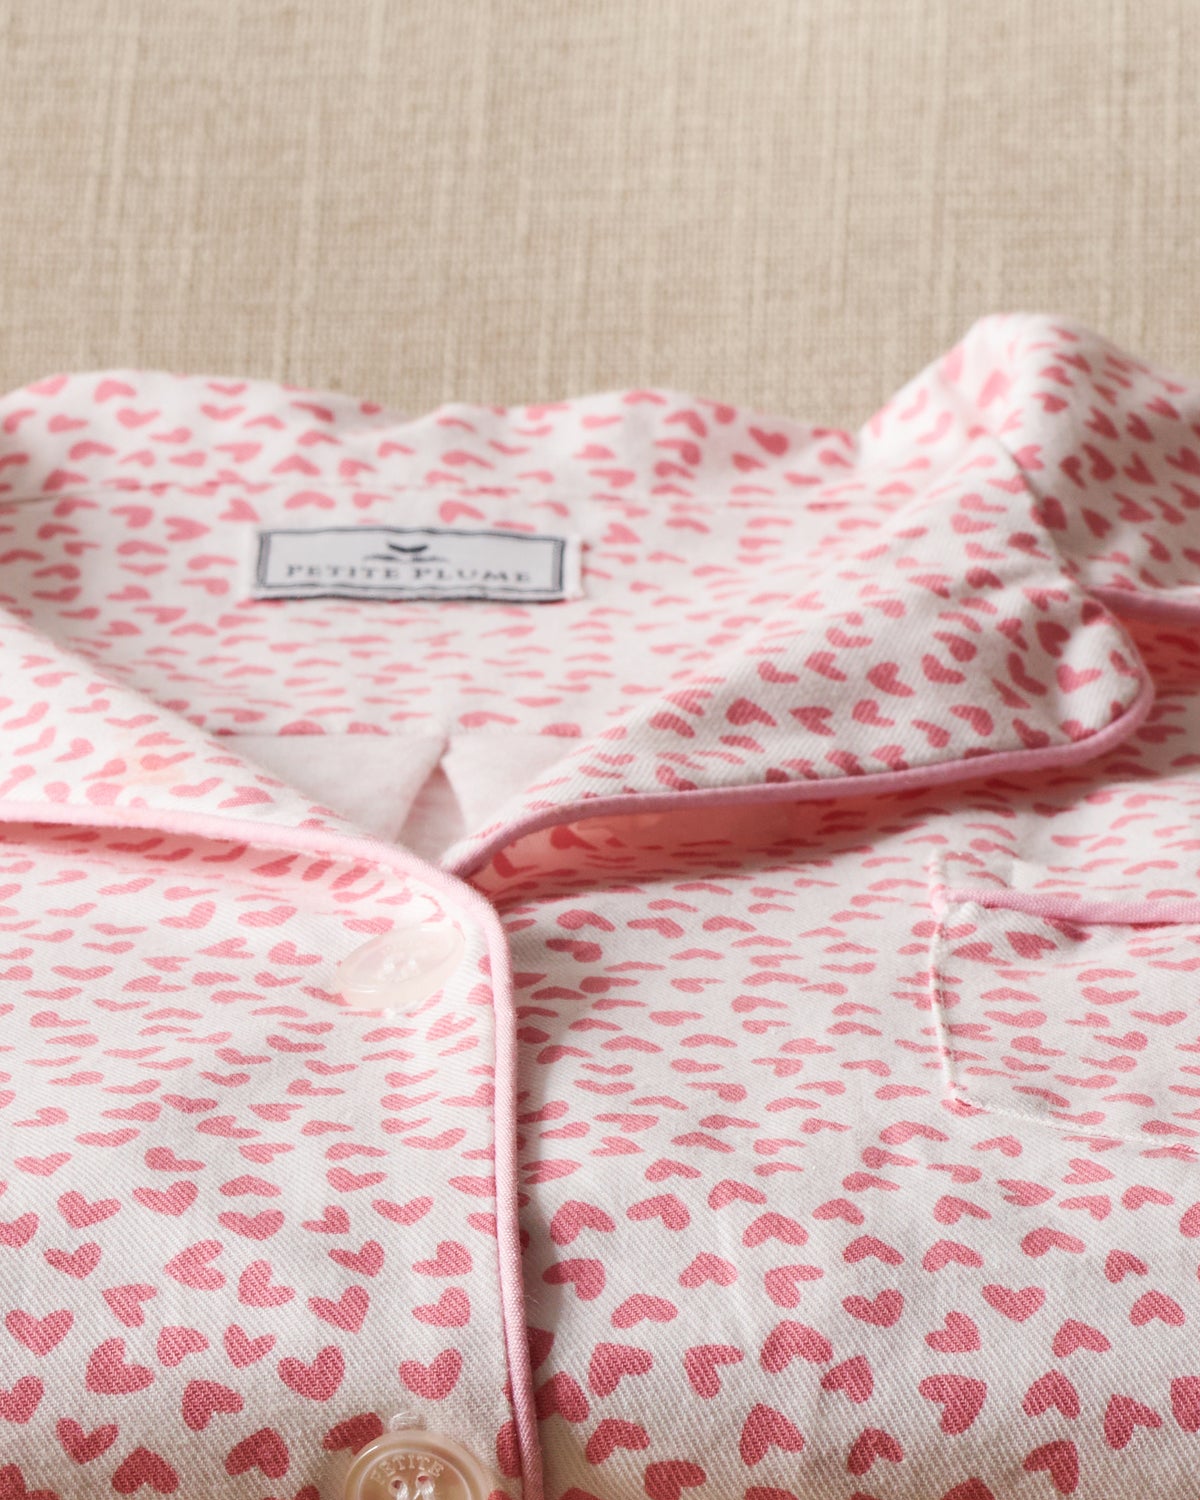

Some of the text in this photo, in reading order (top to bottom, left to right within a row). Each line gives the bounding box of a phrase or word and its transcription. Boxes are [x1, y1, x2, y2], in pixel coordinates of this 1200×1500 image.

[286, 564, 531, 583] PETITE PLUME
[370, 1453, 445, 1485] PETITE
